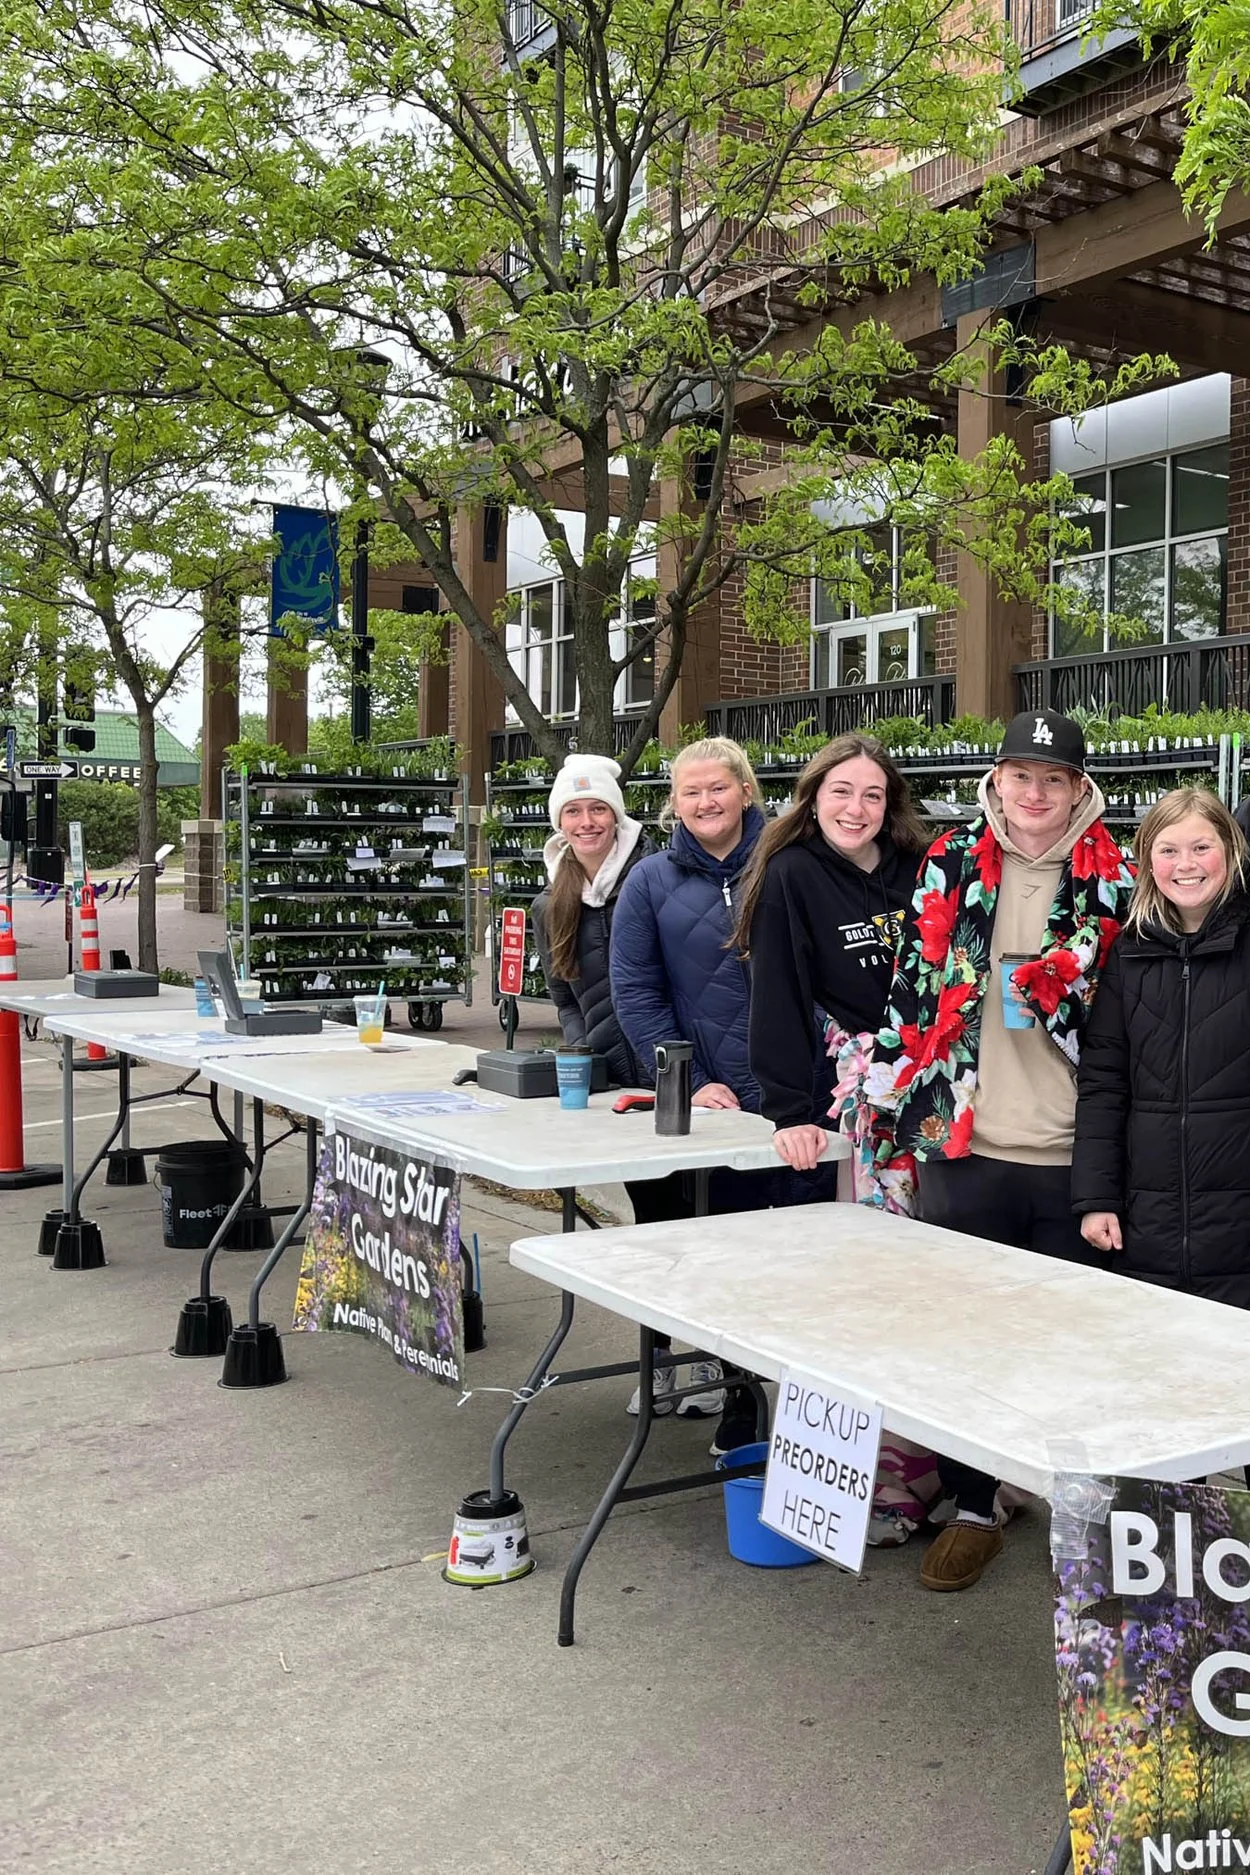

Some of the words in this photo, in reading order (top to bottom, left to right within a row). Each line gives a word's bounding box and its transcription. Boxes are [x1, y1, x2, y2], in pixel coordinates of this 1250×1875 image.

[890, 644, 902, 656] 120
[1032, 717, 1054, 746] LA
[26, 766, 41, 774] ONE
[44, 766, 60, 774] WAY
[81, 764, 141, 779] OFFEE
[335, 1134, 398, 1218] Blazing
[400, 1162, 450, 1226] Star
[179, 1208, 212, 1219] Fleet
[333, 1302, 377, 1333] Native
[784, 1382, 870, 1445] PICKUP
[772, 1433, 870, 1501] PREORDERS
[781, 1489, 842, 1551] HERE
